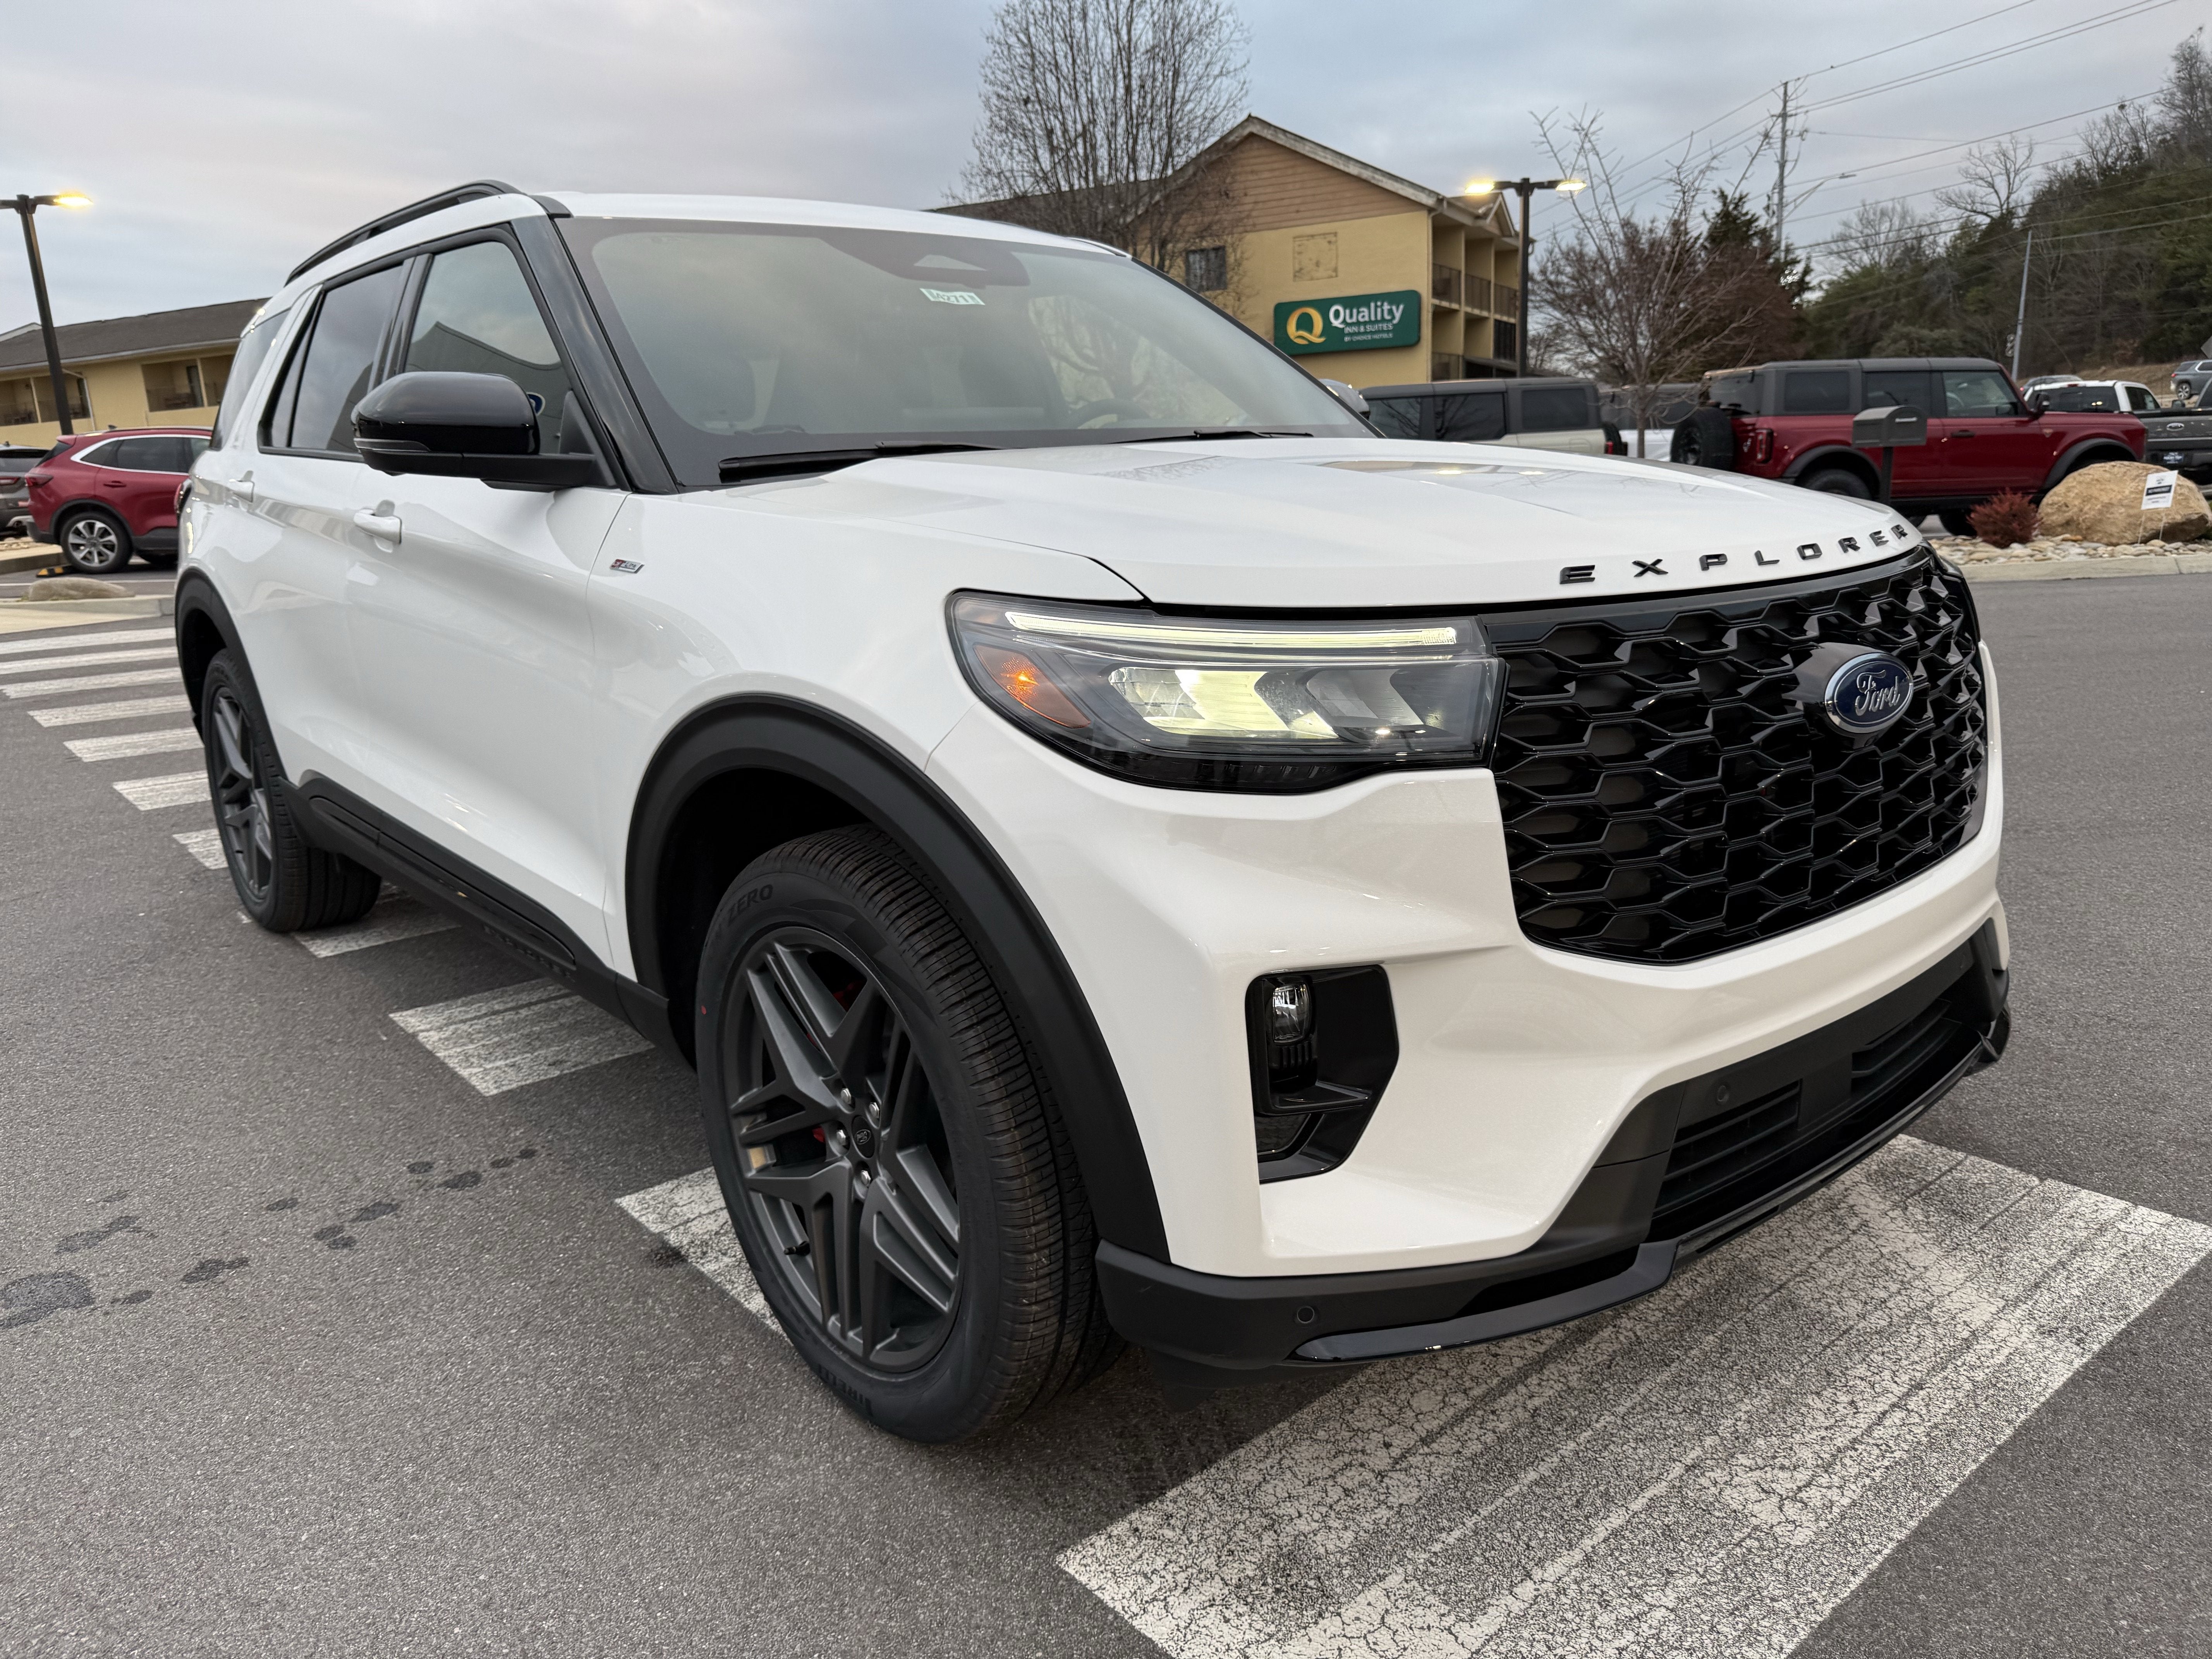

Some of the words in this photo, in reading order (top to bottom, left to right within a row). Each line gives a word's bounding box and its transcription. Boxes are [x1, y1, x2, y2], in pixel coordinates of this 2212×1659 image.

[1286, 307, 1326, 345] Q
[1329, 301, 1404, 328] Quality
[1344, 325, 1359, 334] INN
[1365, 323, 1394, 331] SUITES
[1559, 524, 1908, 584] EXPLORER
[1855, 670, 1900, 716] Ford
[728, 884, 773, 927] ZERO
